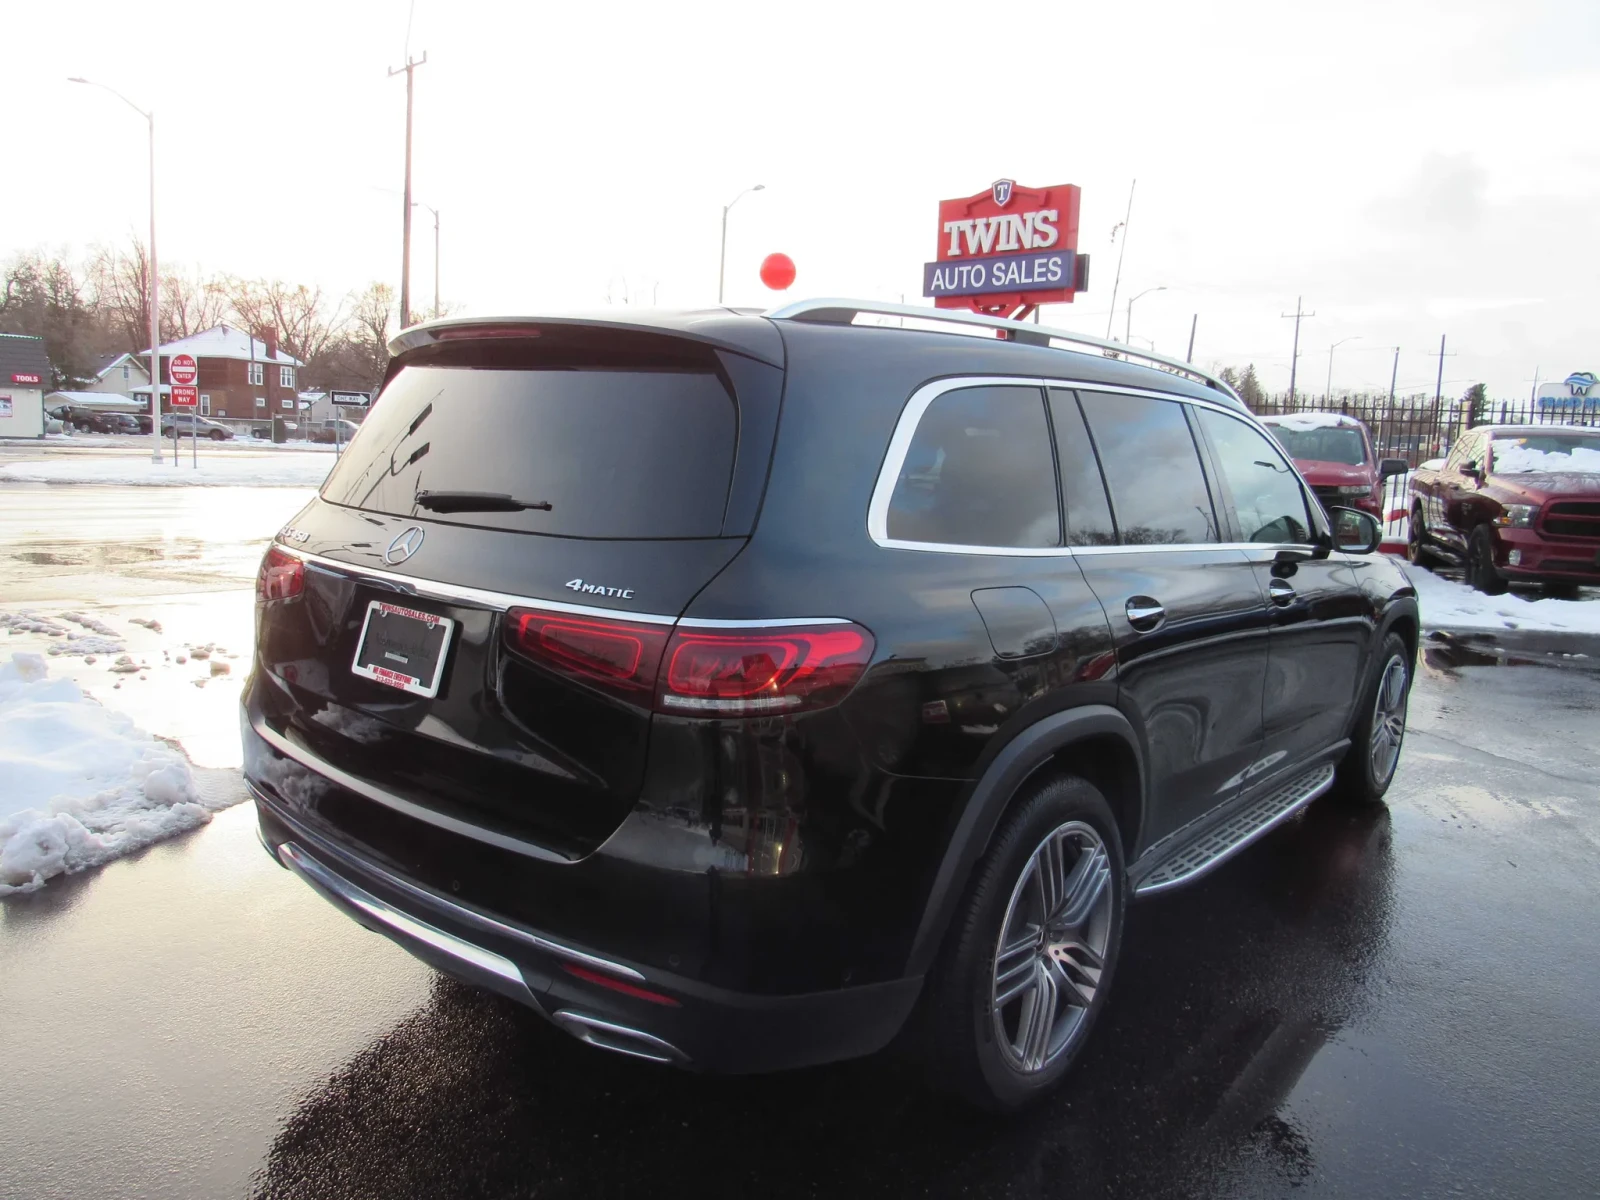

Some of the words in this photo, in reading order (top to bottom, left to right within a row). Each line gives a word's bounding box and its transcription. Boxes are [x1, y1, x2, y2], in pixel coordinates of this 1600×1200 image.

[997, 184, 1008, 201] T
[943, 209, 1059, 256] TWINS
[930, 264, 986, 291] AUTO
[991, 256, 1062, 286] SALES
[15, 374, 39, 383] TOOLS
[173, 388, 195, 396] WRONG
[564, 578, 635, 599] 4MATIC
[379, 602, 441, 625] TWINSAUTOSALES.COM
